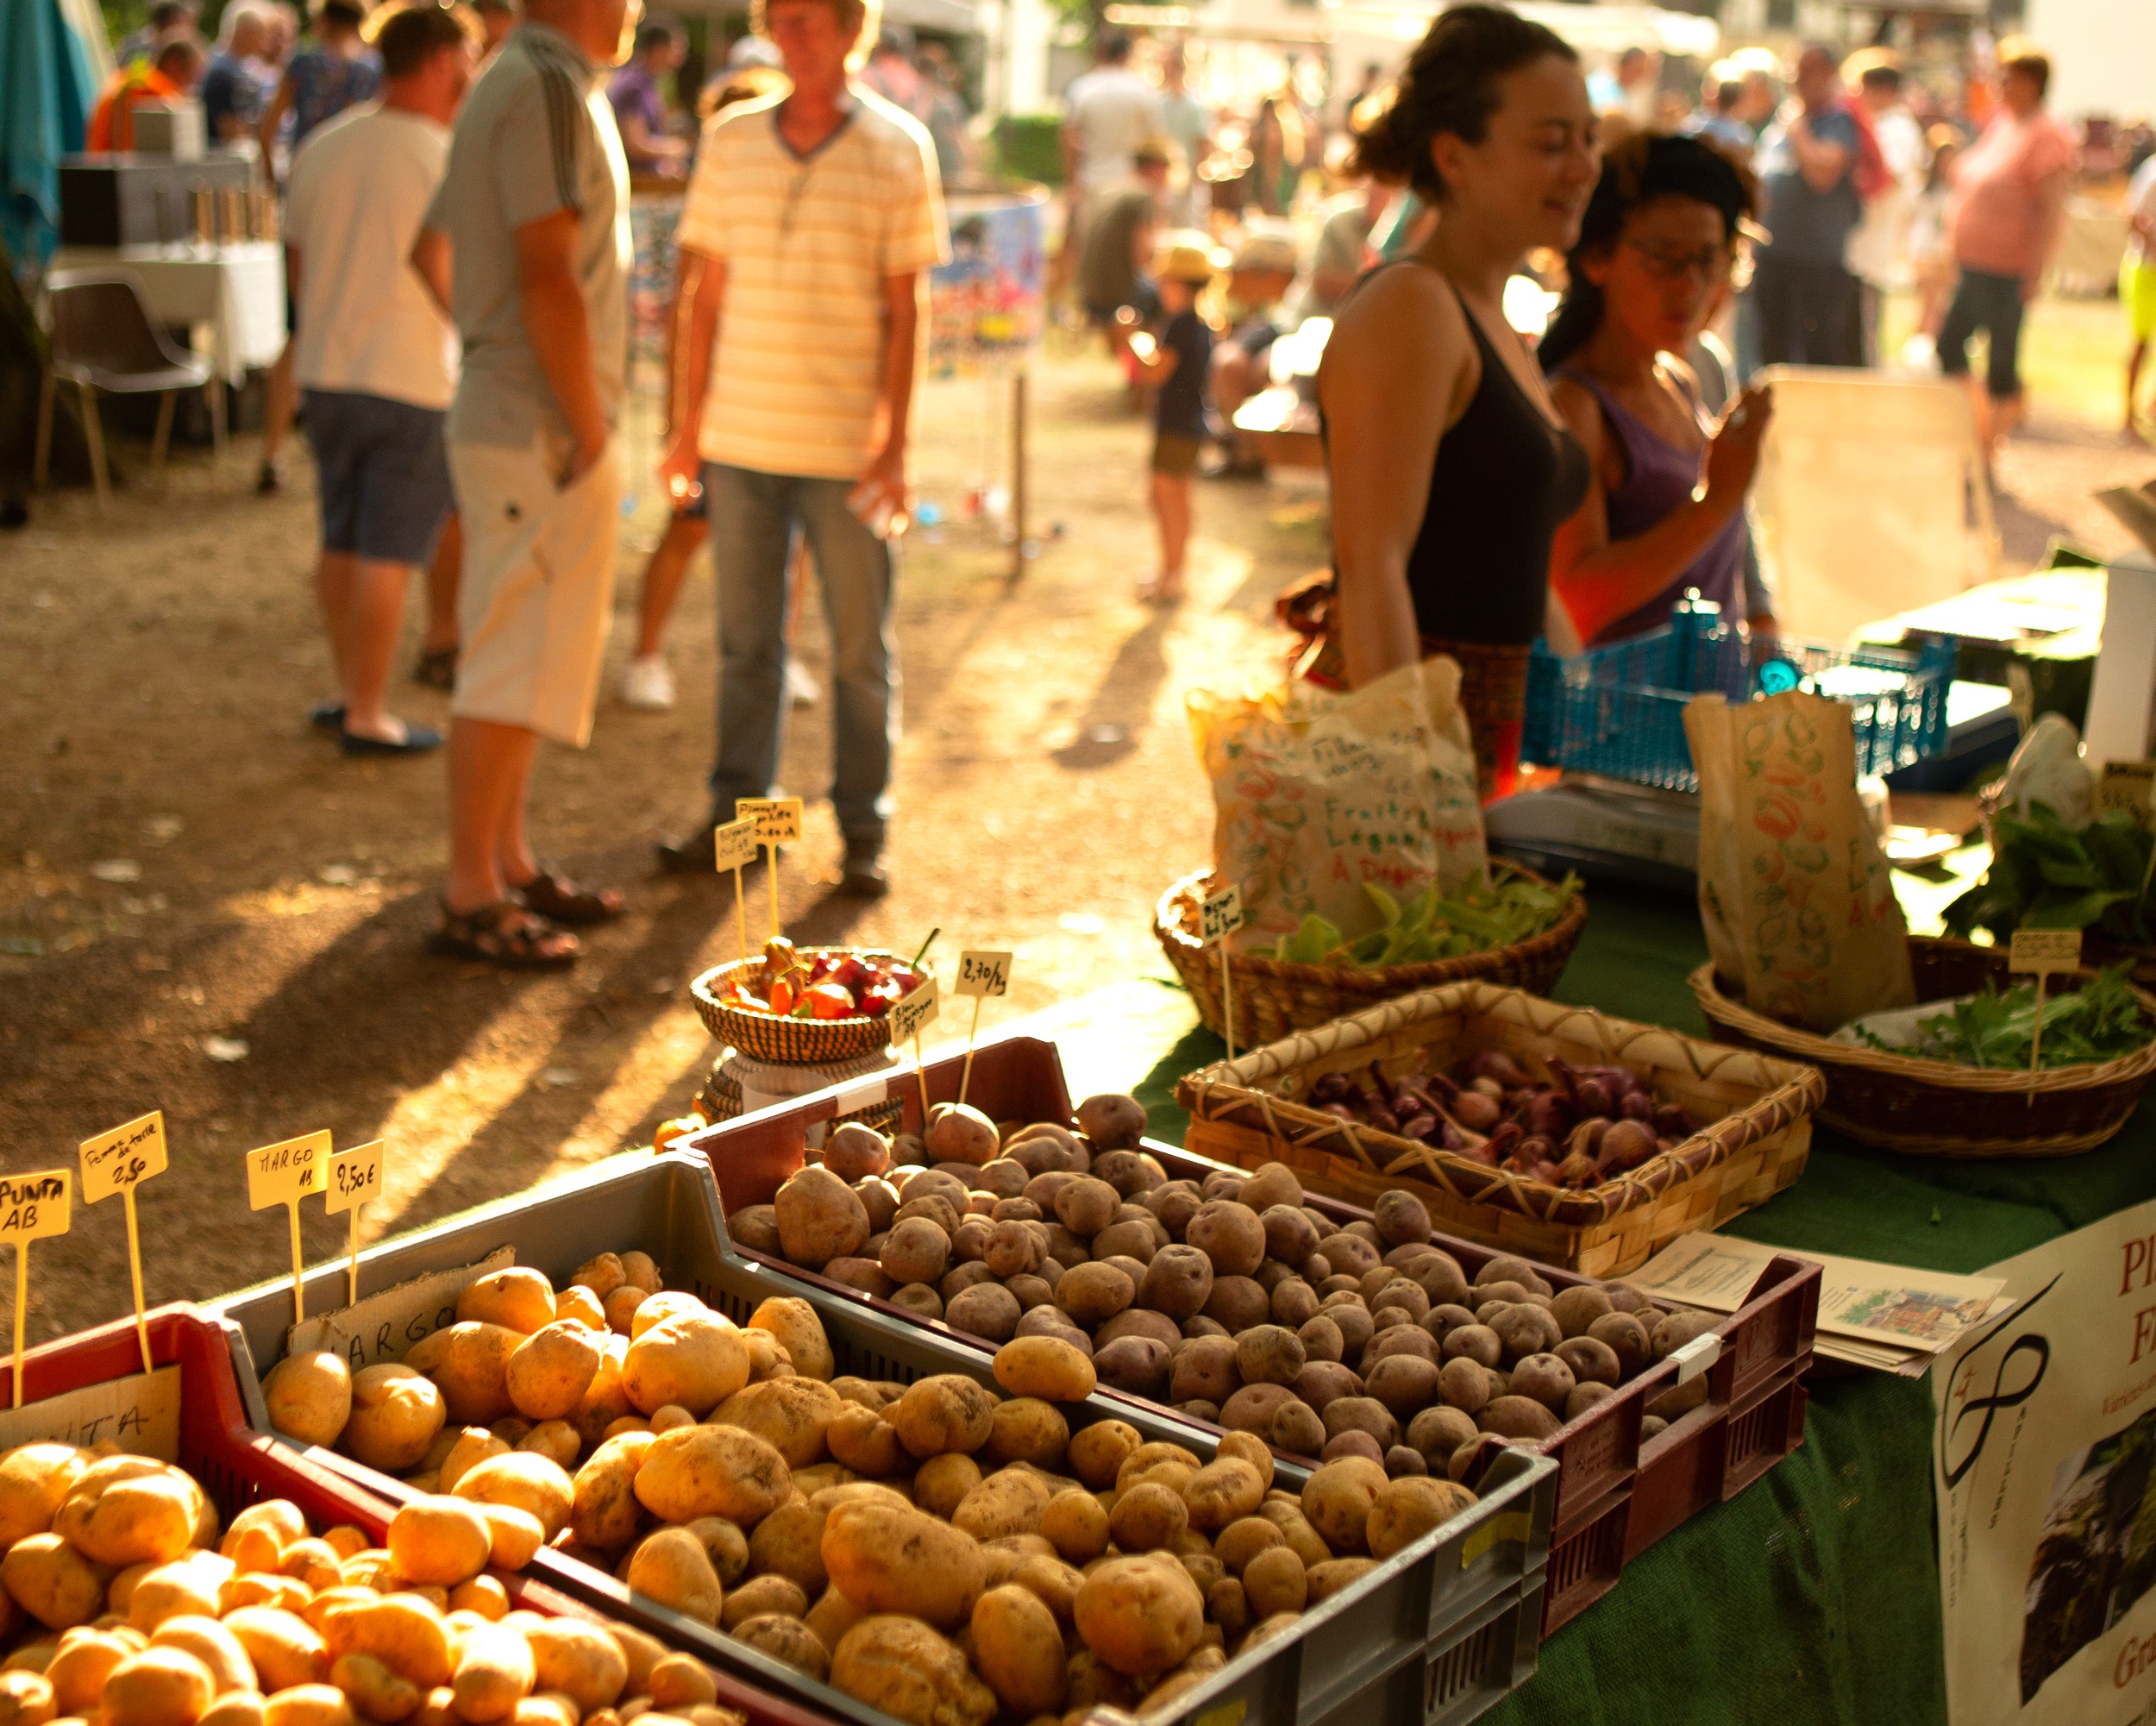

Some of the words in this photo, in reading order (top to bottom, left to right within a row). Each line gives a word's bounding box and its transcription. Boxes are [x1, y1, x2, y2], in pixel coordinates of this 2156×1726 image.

[128, 1123, 157, 1148] terre
[112, 1157, 147, 1185] 2,50
[259, 1148, 313, 1173] MARGO
[298, 1169, 312, 1187] AB
[0, 1177, 64, 1208] PUNTA
[2, 1204, 38, 1232] AB
[2117, 1233, 2156, 1298] Pl
[330, 1306, 456, 1366] ARGO
